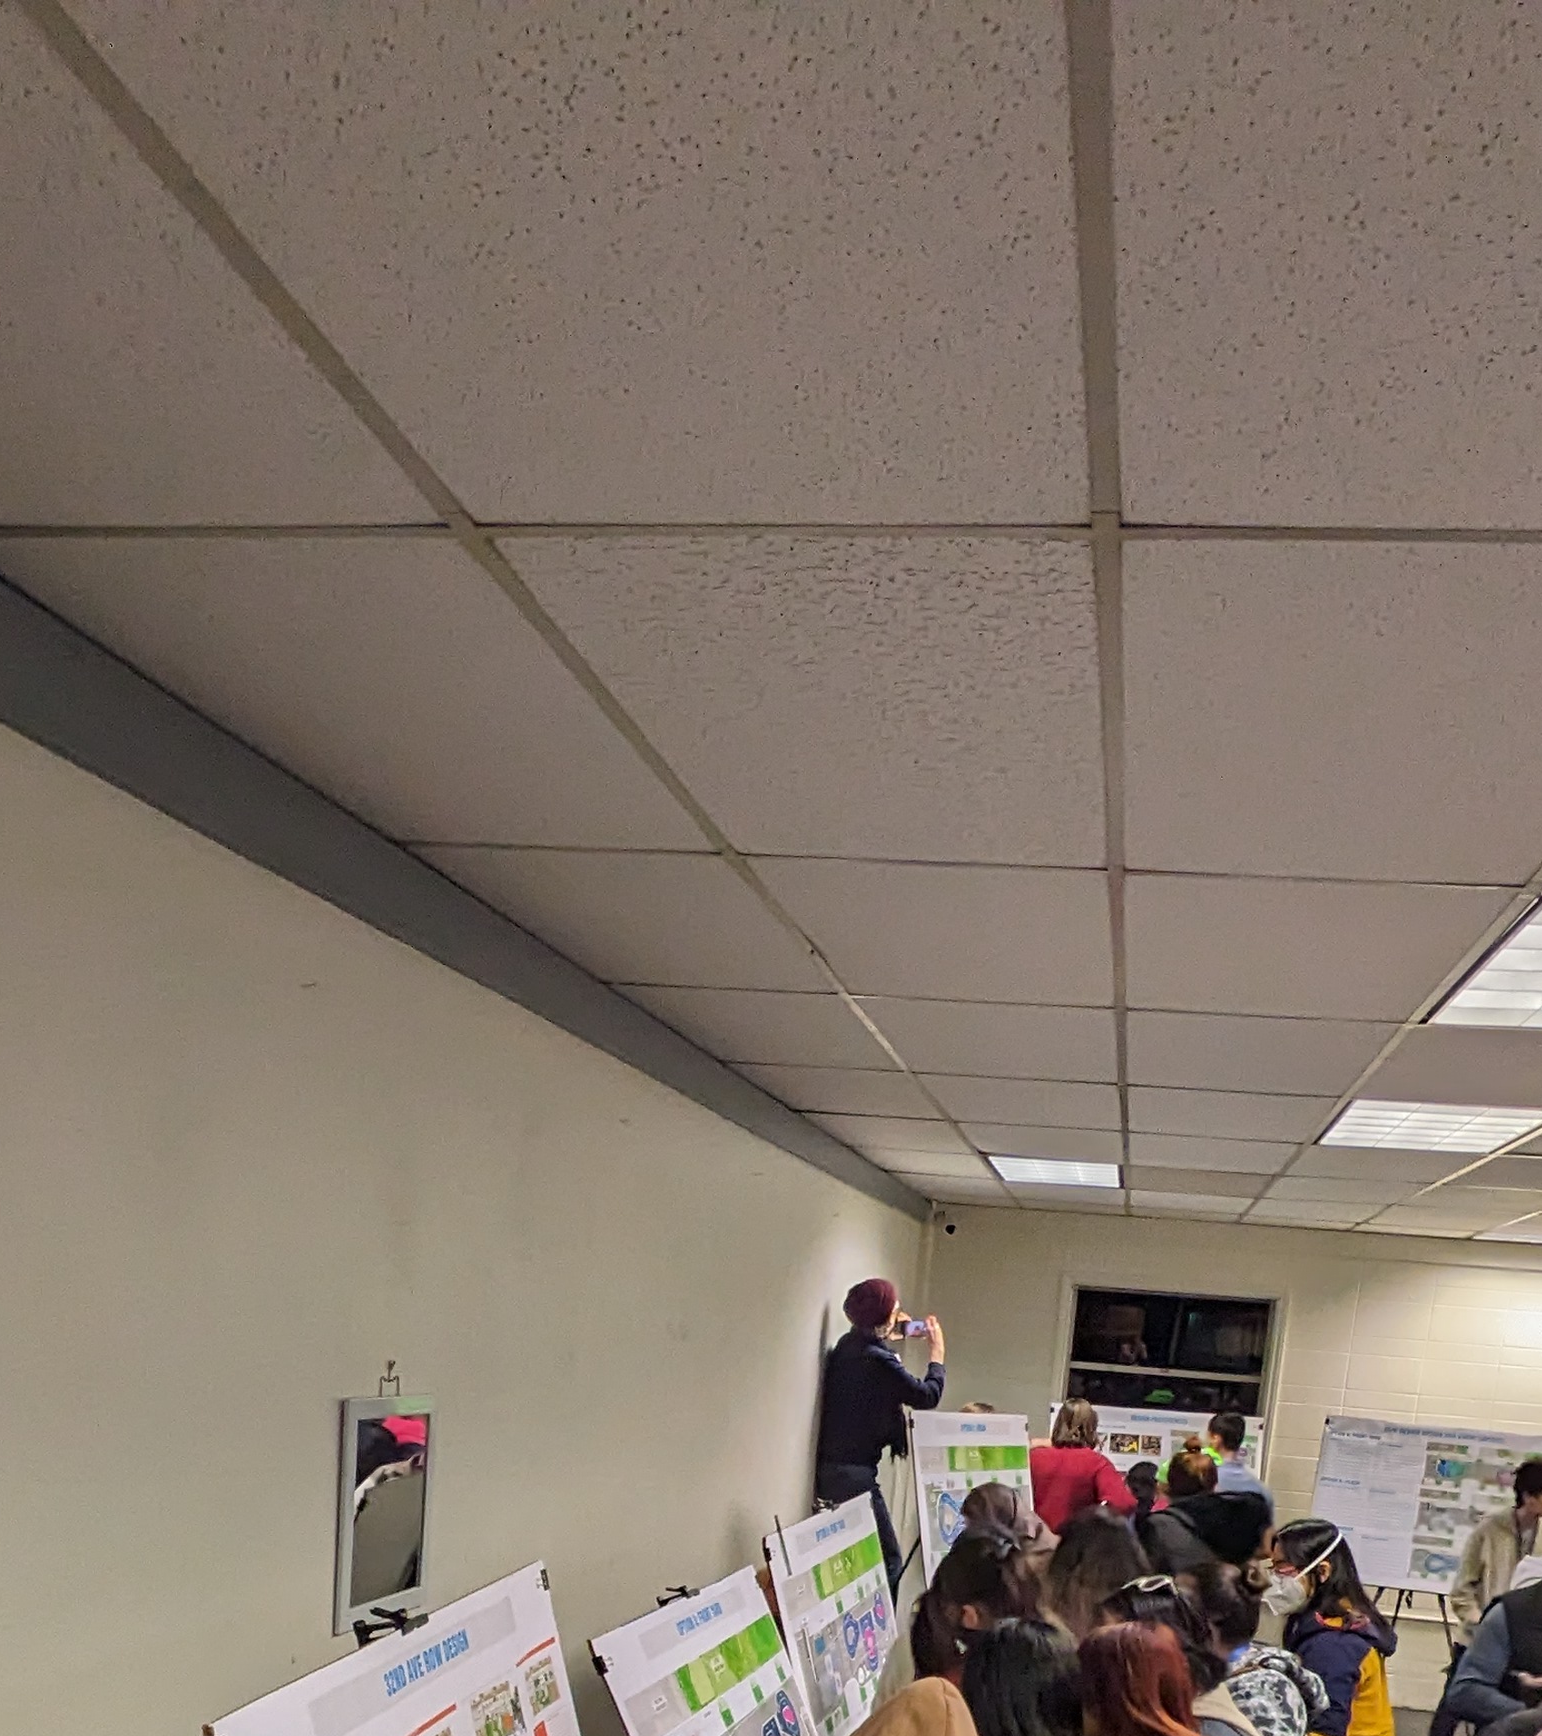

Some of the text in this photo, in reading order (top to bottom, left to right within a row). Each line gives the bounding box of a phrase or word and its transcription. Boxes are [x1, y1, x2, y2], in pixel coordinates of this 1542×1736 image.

[384, 1629, 469, 1697] 32ND AVE ROW DESIGN
